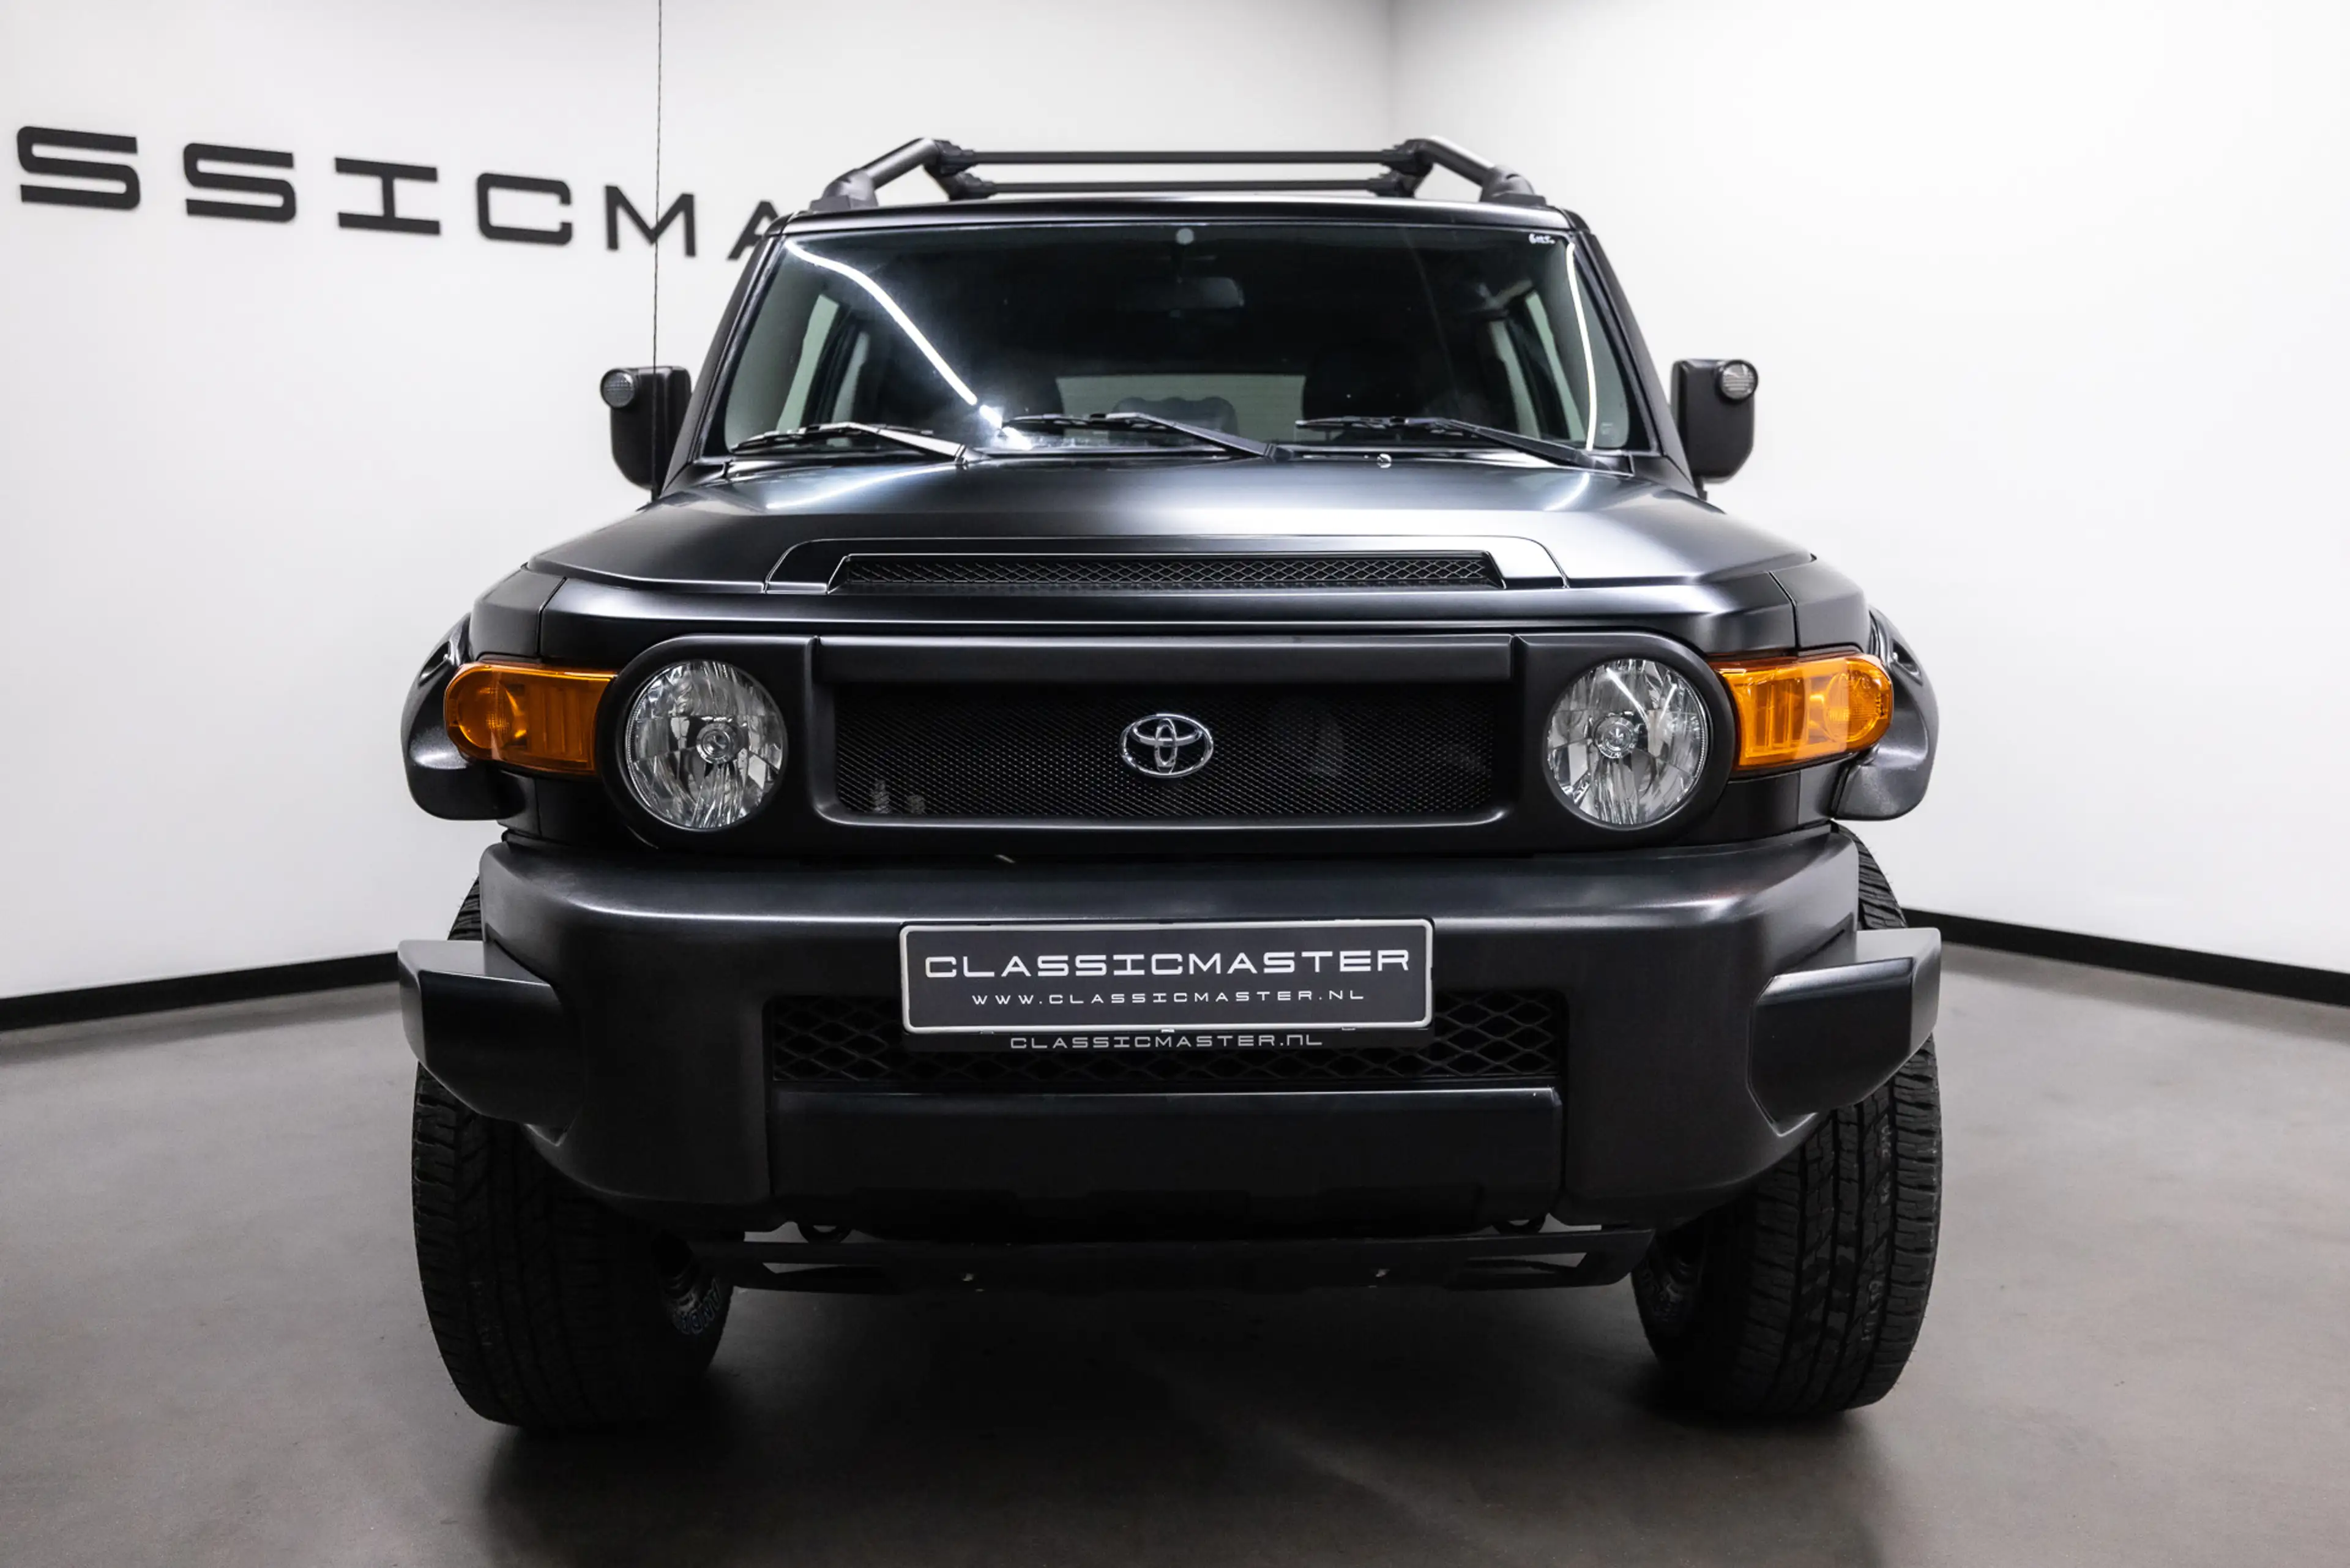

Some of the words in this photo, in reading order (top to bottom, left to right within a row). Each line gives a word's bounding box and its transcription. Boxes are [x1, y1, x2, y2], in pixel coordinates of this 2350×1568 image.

[925, 949, 1409, 978] CLASSICMASTER
[972, 990, 1364, 1005] WWW.CLASSICMASTER.NL
[1010, 1034, 1322, 1049] CLASSICMASTER.NL
